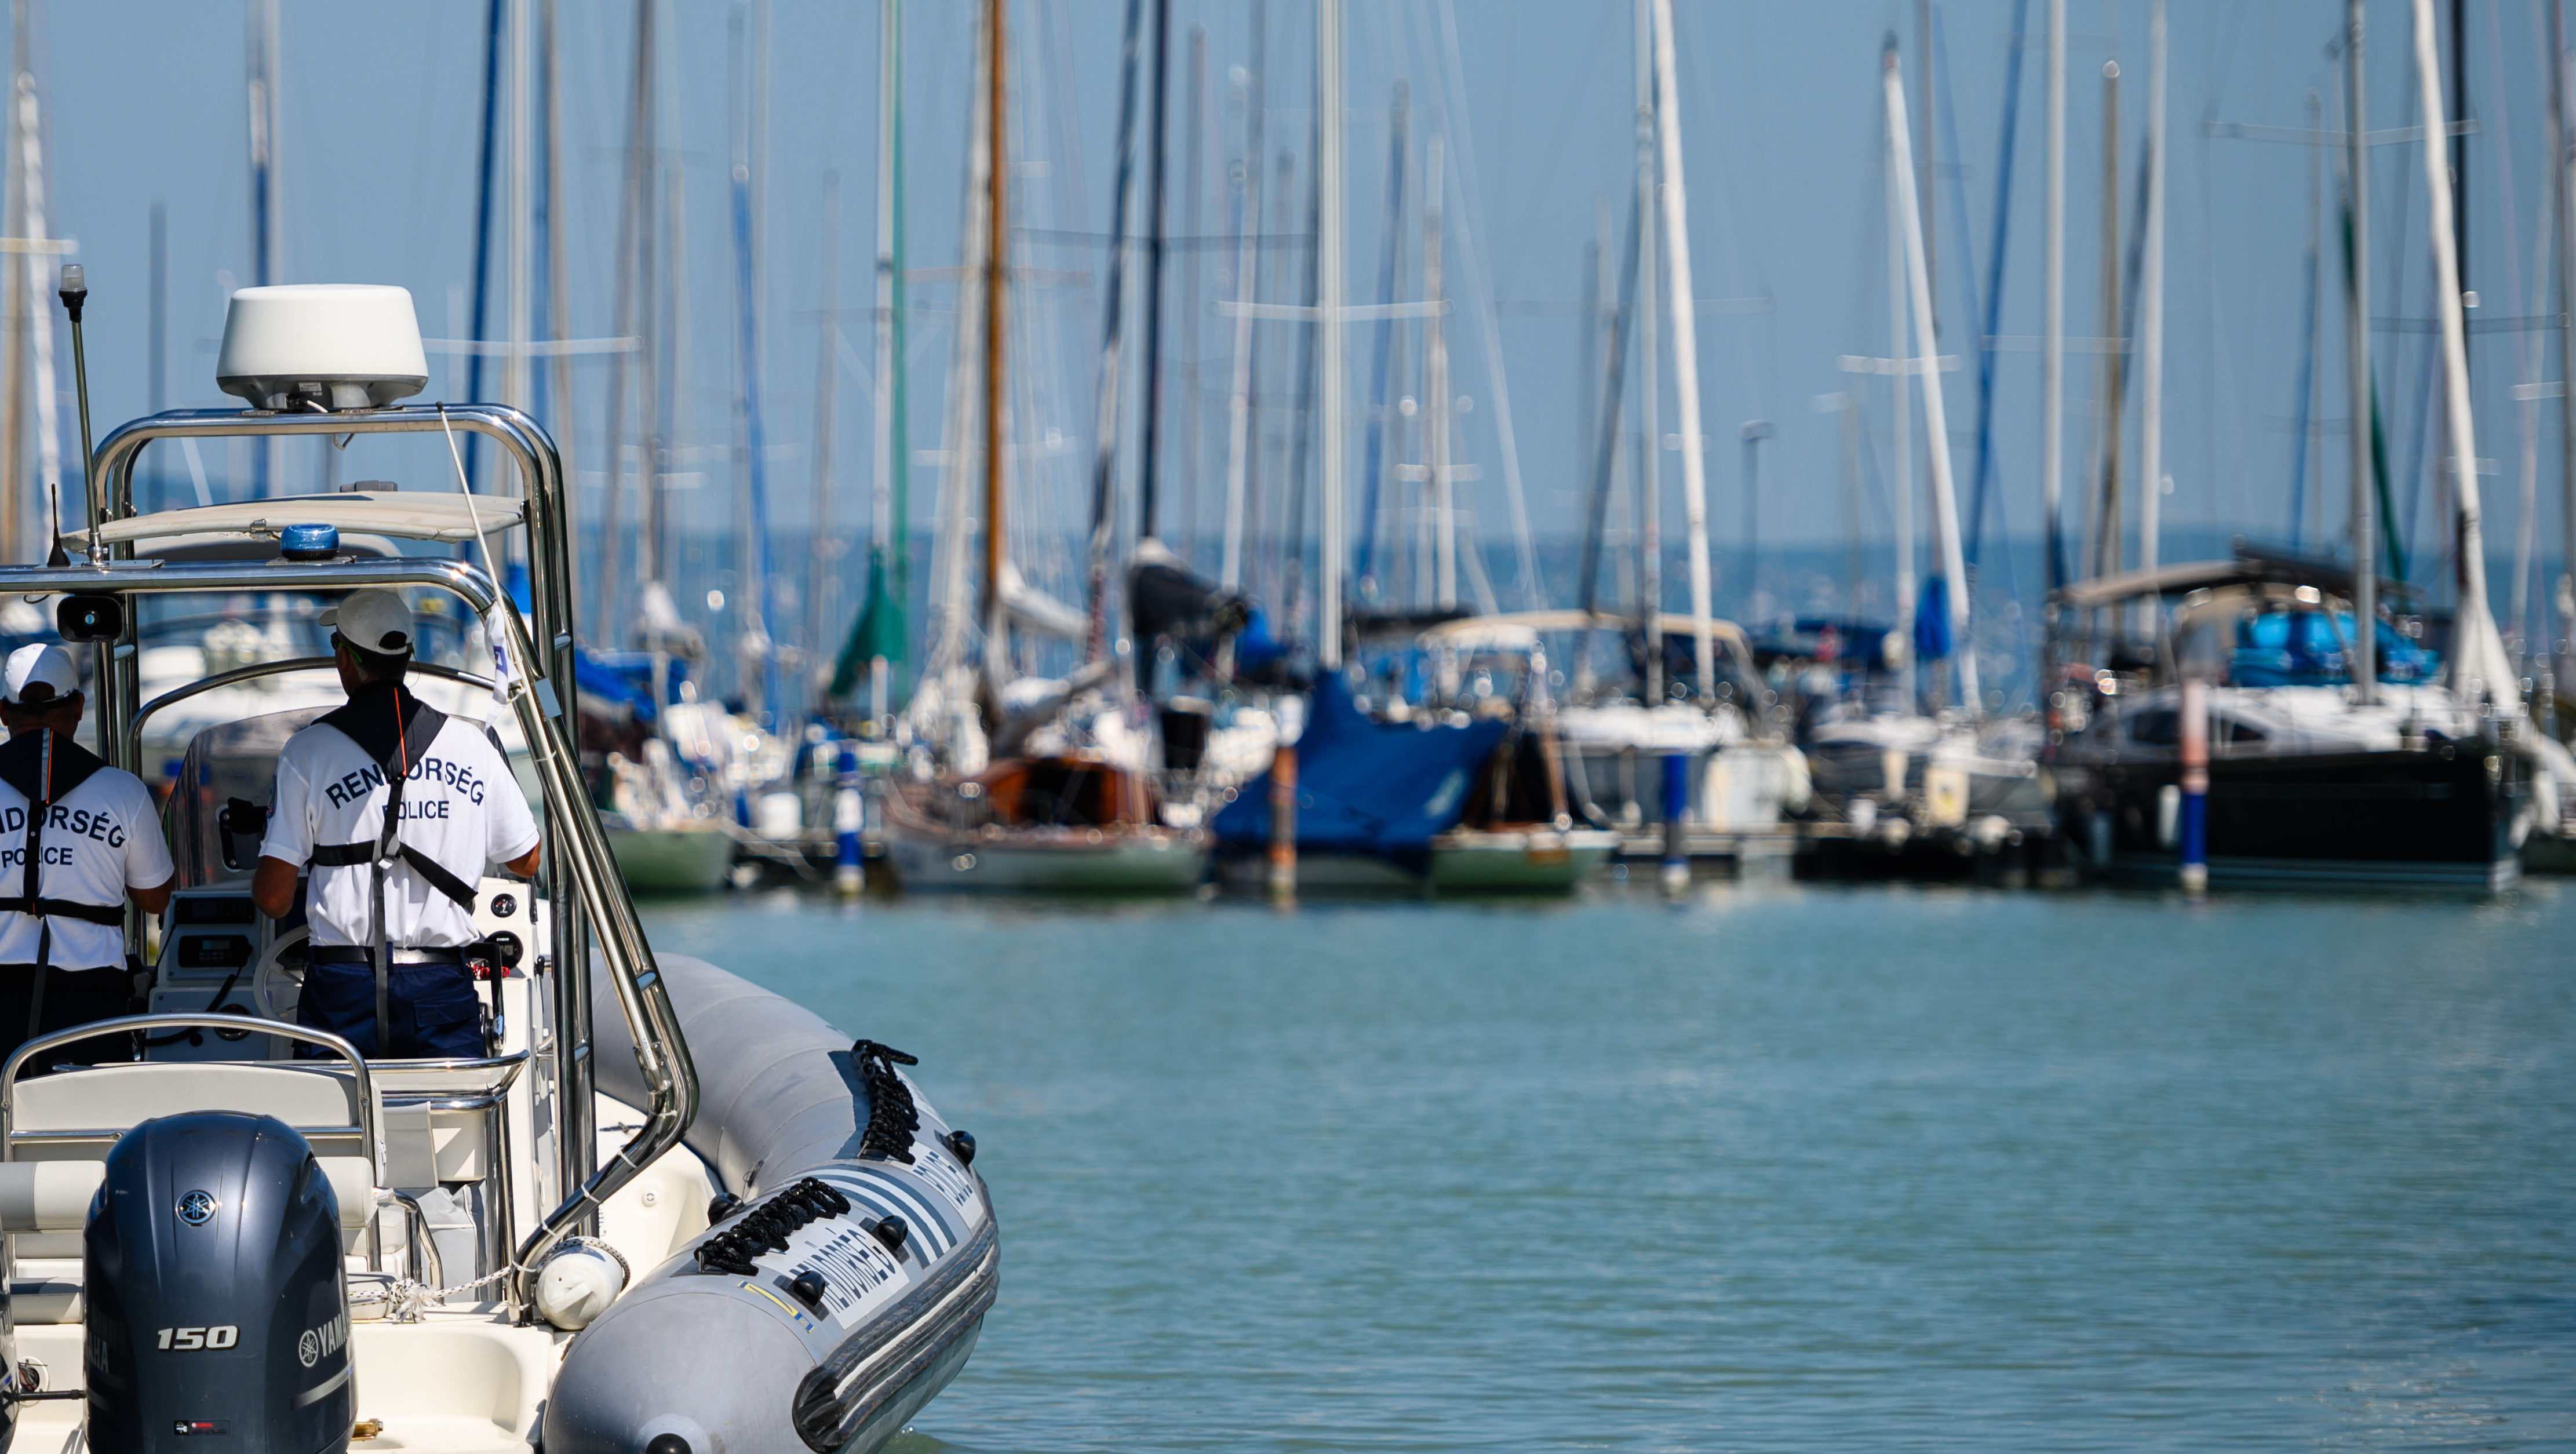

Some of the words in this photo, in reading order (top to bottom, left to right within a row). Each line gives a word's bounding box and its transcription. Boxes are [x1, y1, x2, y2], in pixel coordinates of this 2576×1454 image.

[325, 757, 484, 810] RENRSÉG
[1, 847, 73, 868] POICE
[913, 1151, 973, 1209] POLICE
[85, 1331, 109, 1374] AHA
[158, 1325, 239, 1350] 150
